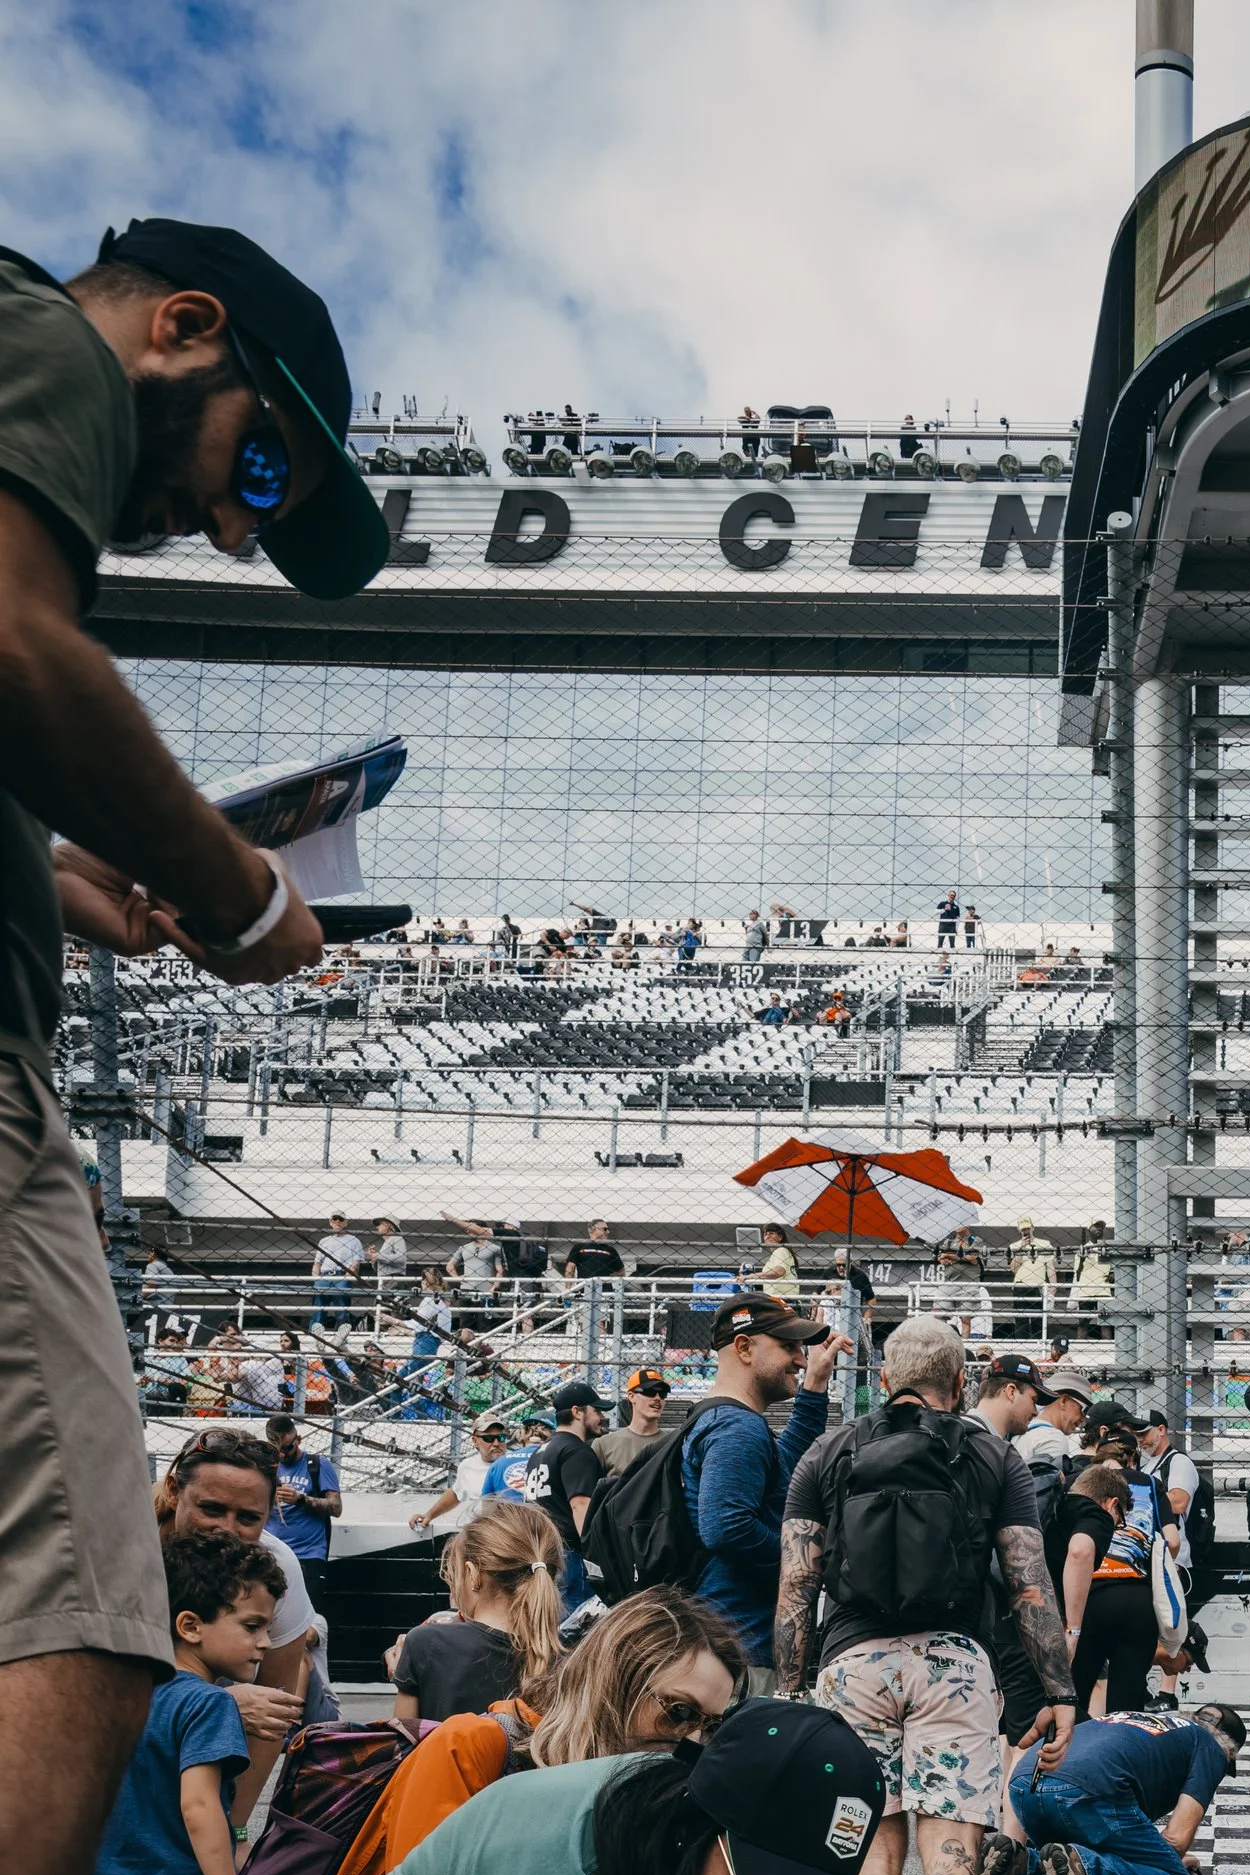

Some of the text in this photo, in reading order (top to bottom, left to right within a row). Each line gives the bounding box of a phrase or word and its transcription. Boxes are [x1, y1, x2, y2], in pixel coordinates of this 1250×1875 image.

[718, 491, 1067, 573] CEN
[159, 960, 194, 981] 353
[729, 965, 764, 987] 352
[868, 1264, 893, 1283] 147
[840, 1803, 869, 1821] ROLEX
[834, 1816, 865, 1837] 24
